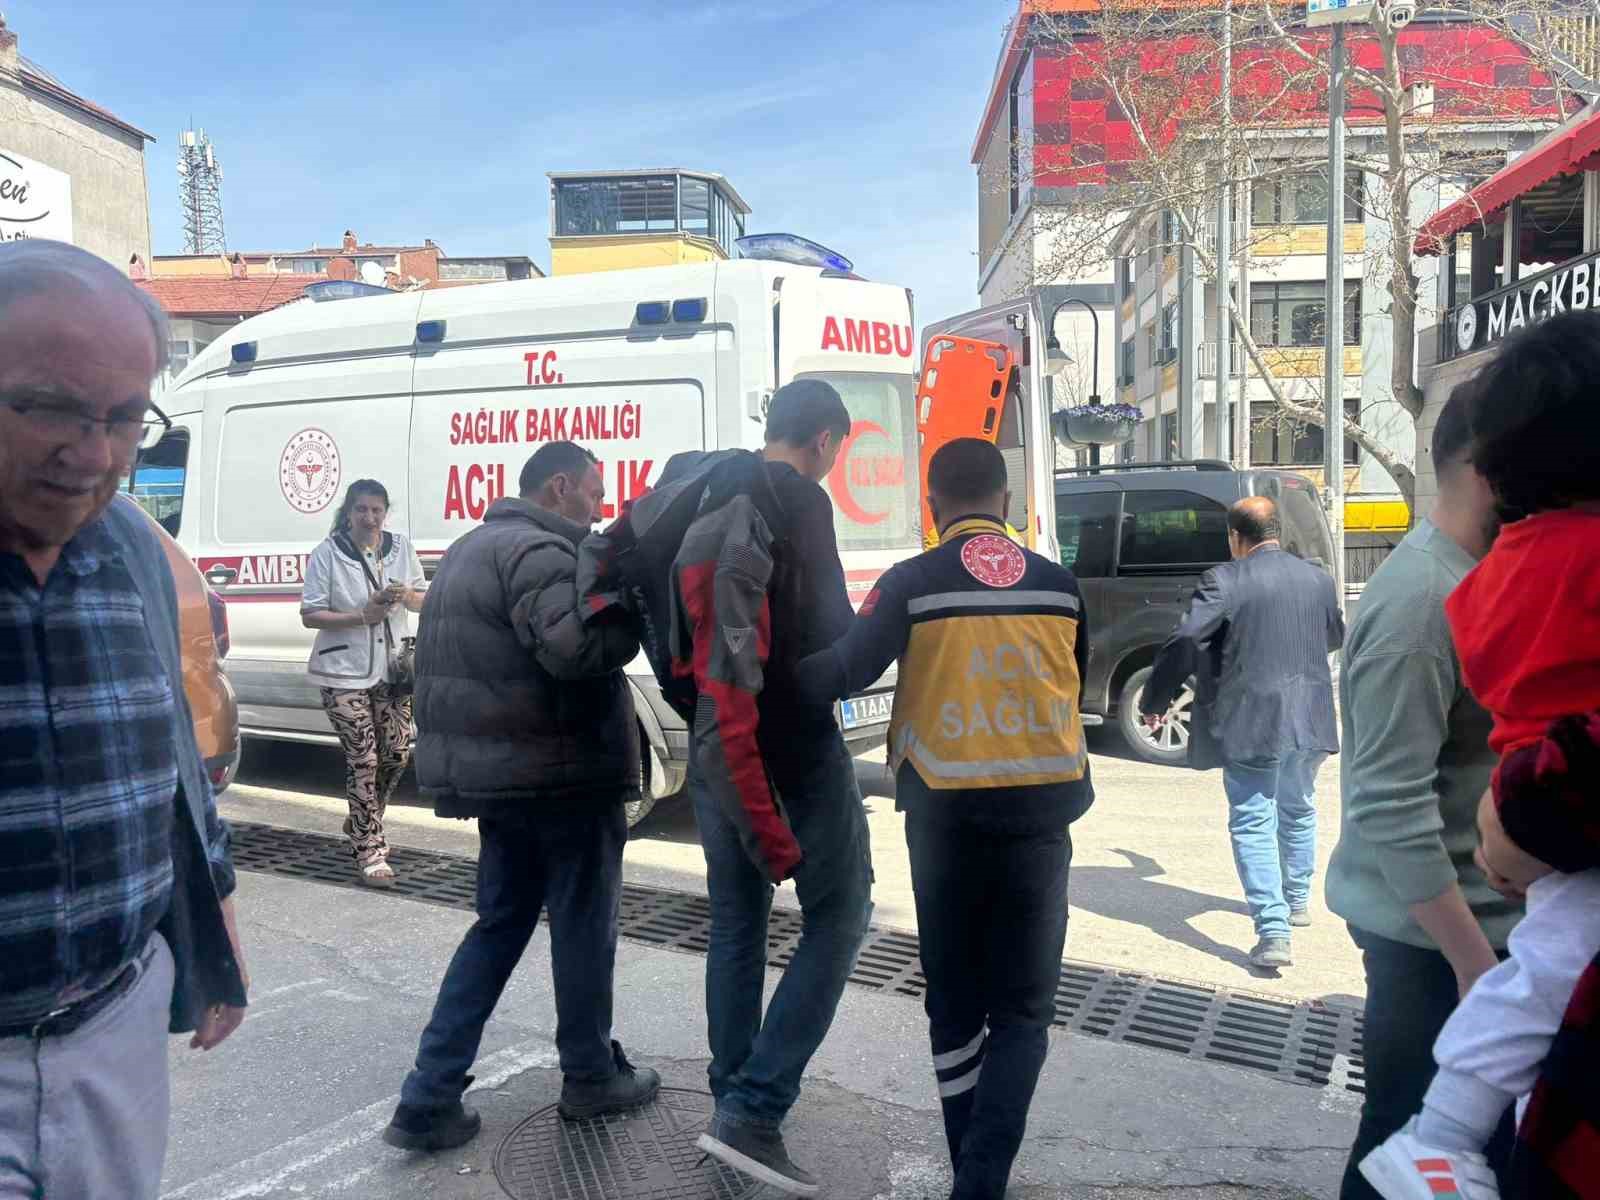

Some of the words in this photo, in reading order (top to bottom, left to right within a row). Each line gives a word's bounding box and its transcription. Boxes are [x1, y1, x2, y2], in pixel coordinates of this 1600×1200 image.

[821, 315, 913, 357] AMBU
[524, 350, 564, 385] T.C.
[450, 408, 519, 445] SAĞLIK
[525, 399, 641, 442] BAKANLIĞI
